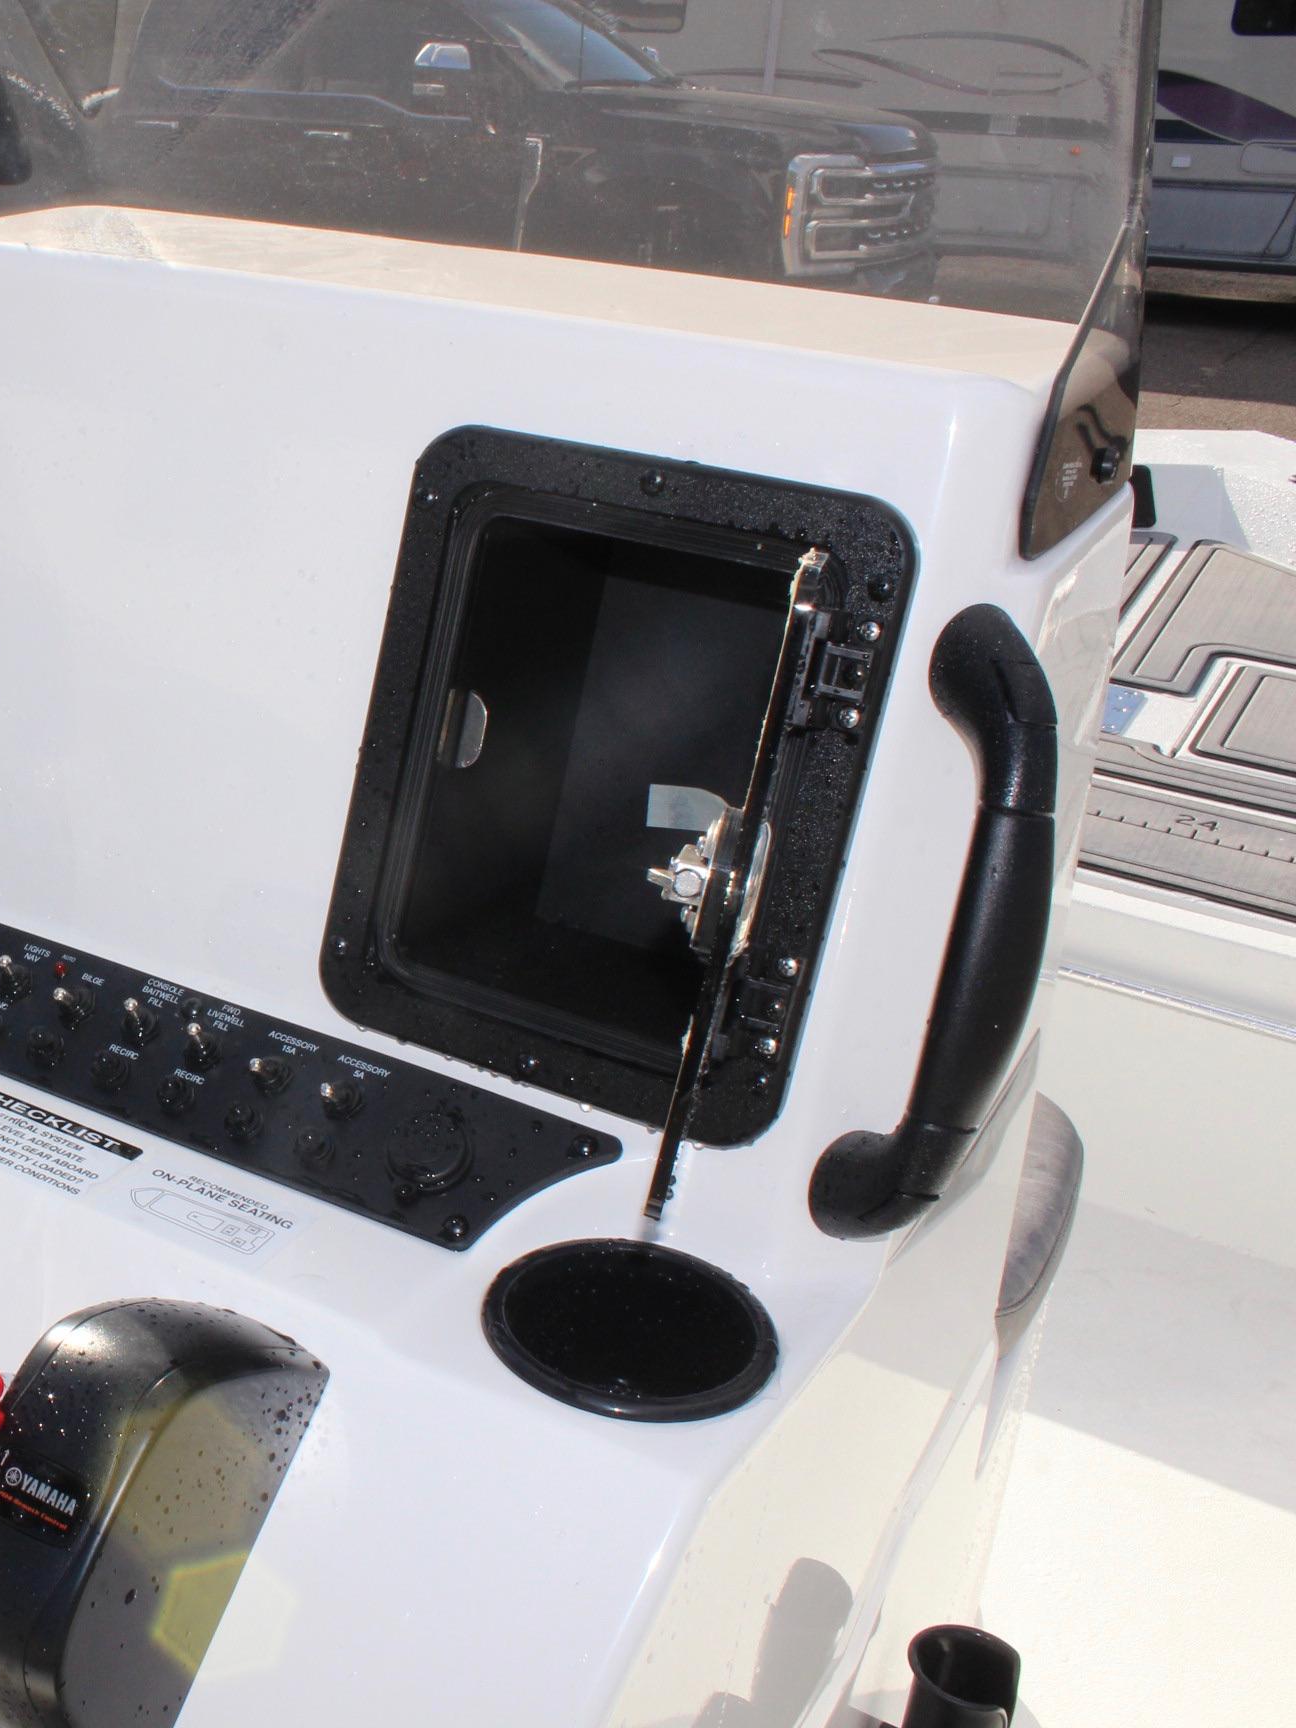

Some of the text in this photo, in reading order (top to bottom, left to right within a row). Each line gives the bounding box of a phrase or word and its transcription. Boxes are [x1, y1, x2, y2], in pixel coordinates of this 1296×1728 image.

[1175, 813, 1219, 832] 24
[24, 944, 52, 957] LIGHTS
[24, 952, 41, 963] NAV
[81, 972, 105, 986] BILGE
[147, 978, 185, 997] CONSOLE
[142, 986, 179, 1005] BAITWELL
[147, 997, 164, 1008] FILL
[207, 1009, 245, 1027] LIVEWELL
[222, 1004, 241, 1016] FWD
[212, 1020, 229, 1032] FILL
[268, 1030, 320, 1053] ACCESSORY
[282, 1044, 296, 1055] 15A
[109, 1043, 140, 1061] RECIRC
[337, 1054, 391, 1078] ACCESSORY
[353, 1070, 365, 1080] 5A
[174, 1068, 205, 1085] RECIRC
[29, 1136, 87, 1164] ADEQUATE
[39, 1130, 85, 1152] SYSTEM
[21, 1142, 52, 1162] GEAR
[52, 1157, 99, 1180] ABOARD
[14, 1164, 82, 1196] CONDITIONS
[32, 1160, 84, 1184] LOADED?
[152, 1168, 295, 1230] ON-PLANE SEATING
[188, 1175, 269, 1211] RECOMMENDED
[21, 1473, 77, 1517] YAMAHA
